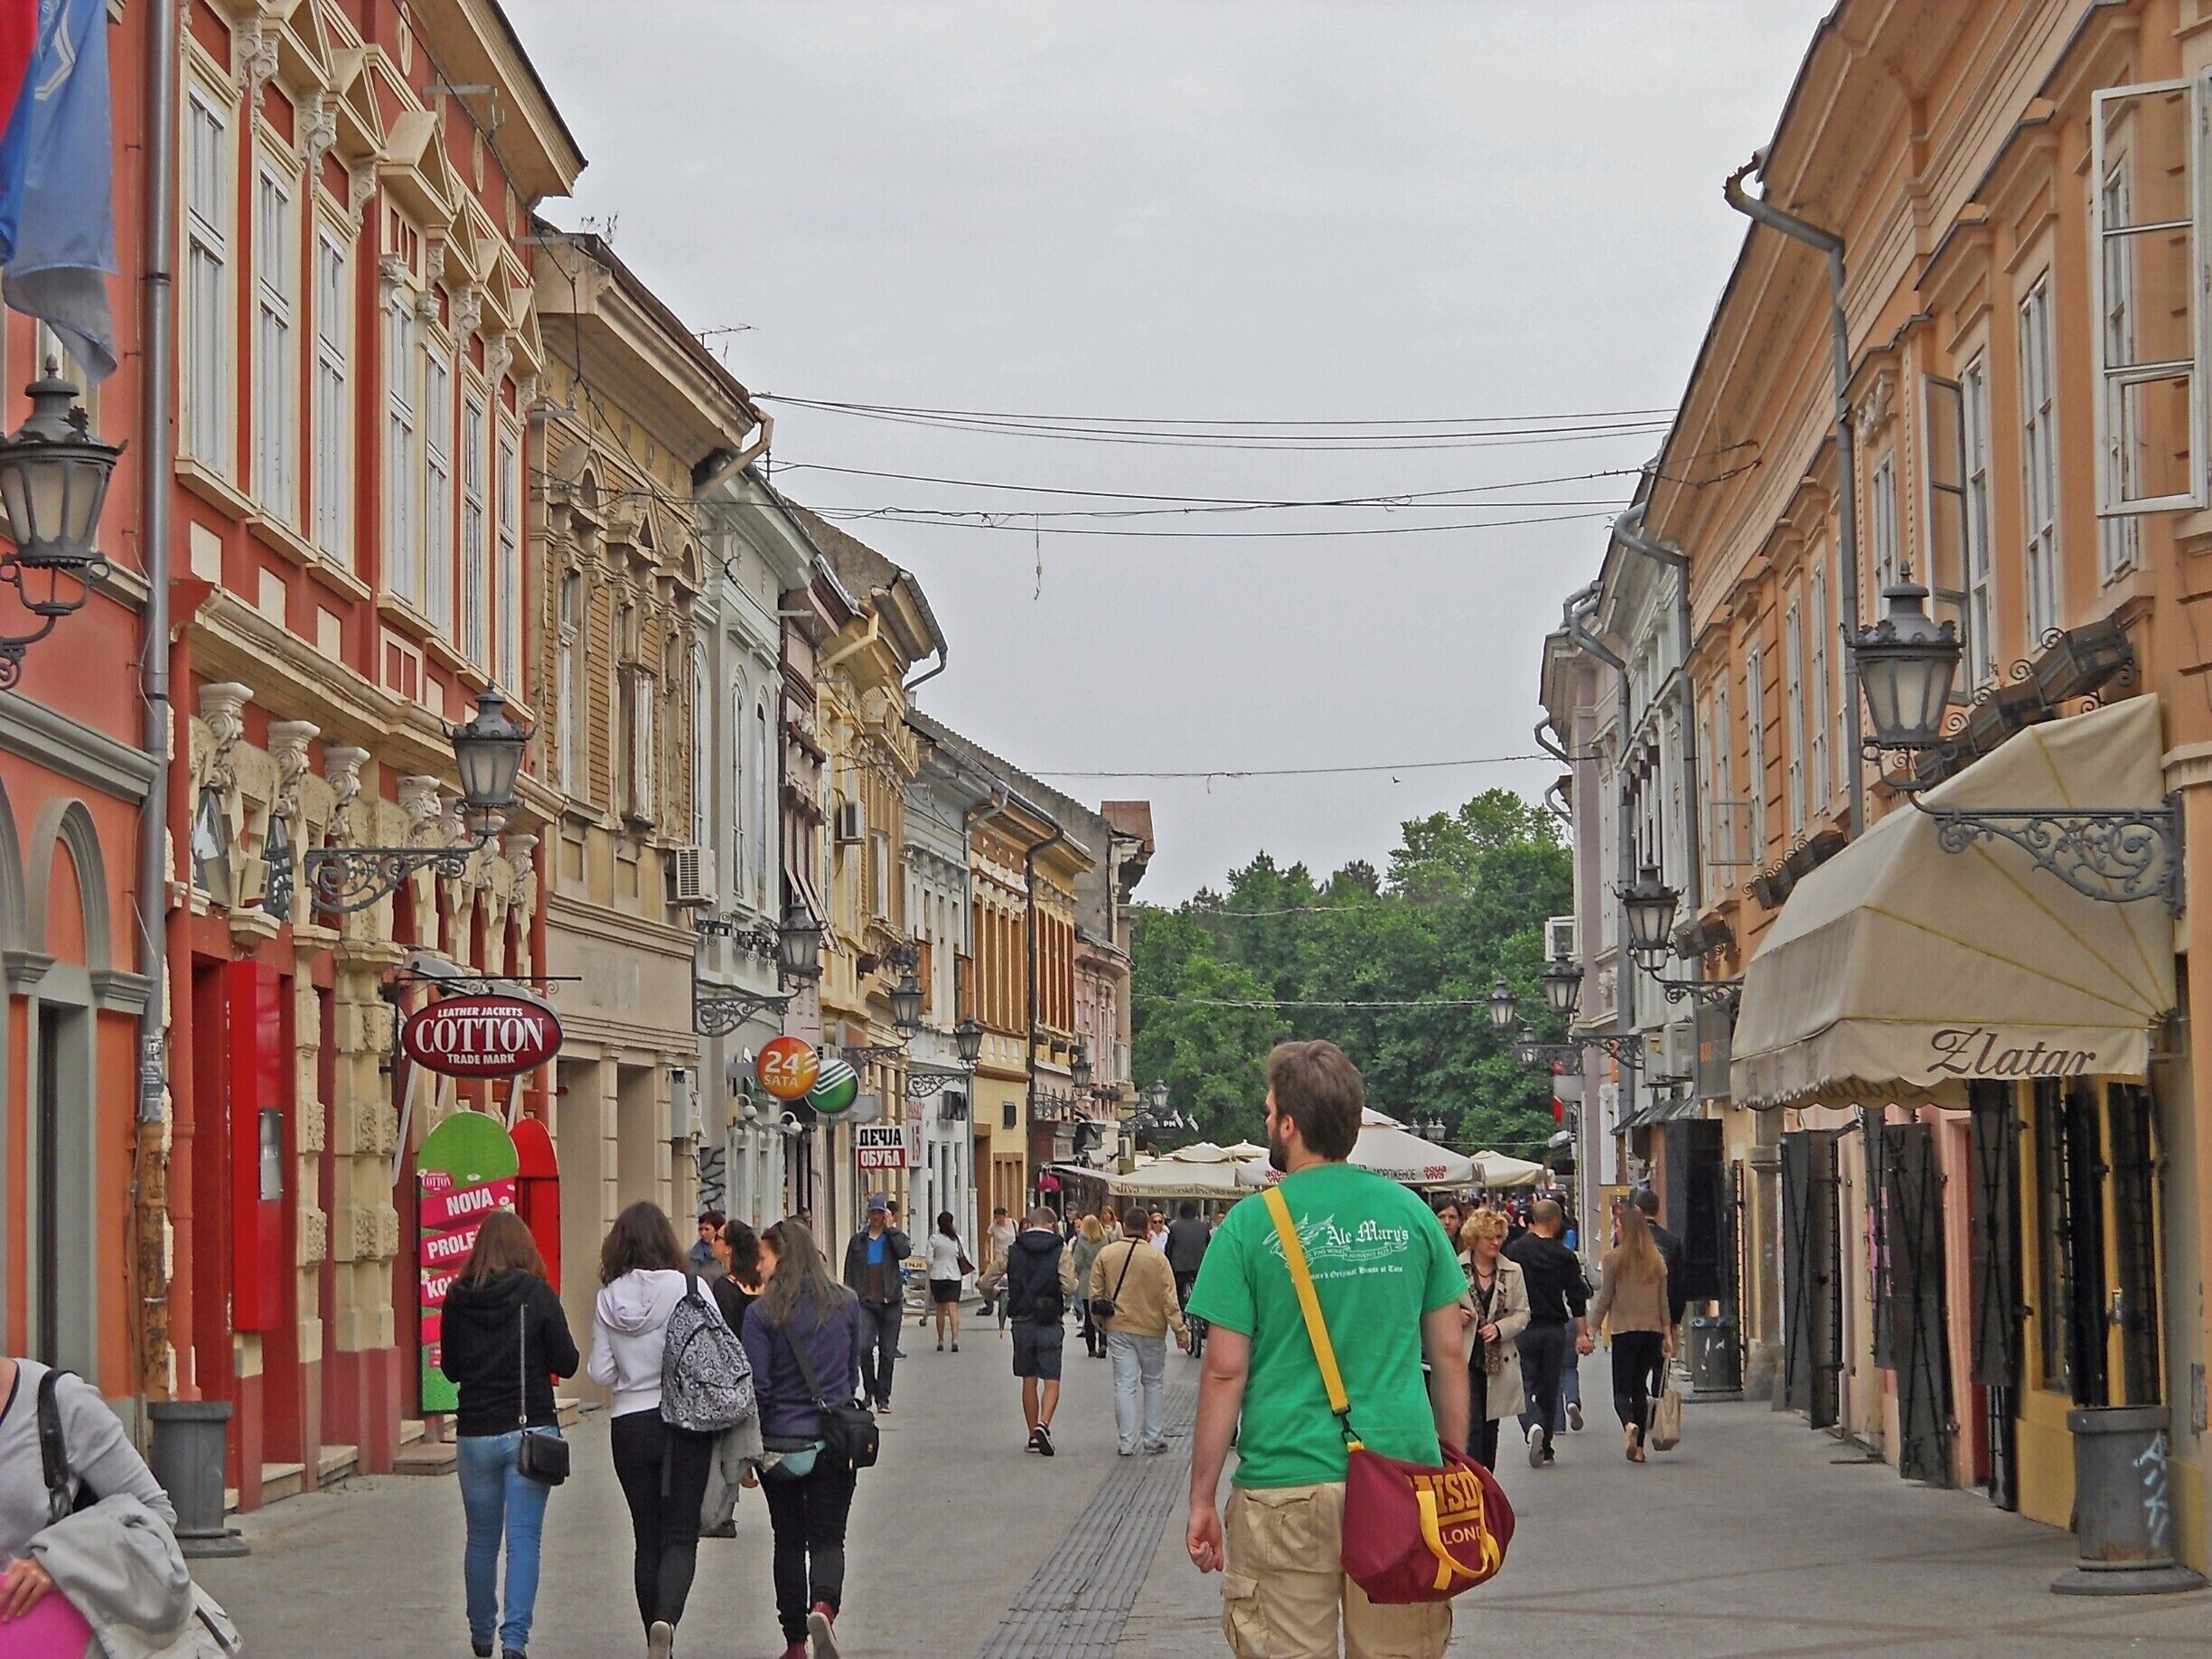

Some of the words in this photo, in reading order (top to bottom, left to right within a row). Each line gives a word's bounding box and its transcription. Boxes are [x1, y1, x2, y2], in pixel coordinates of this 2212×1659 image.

[437, 1008, 479, 1017] LEATHER
[481, 1007, 523, 1017] JACKETS
[415, 1017, 544, 1054] COTTON
[447, 1054, 480, 1064] TRADE
[483, 1053, 515, 1064] MARK
[1926, 1027, 2096, 1075] Zlatar
[764, 1050, 801, 1074] 24
[764, 1075, 799, 1088] SATA
[859, 1128, 903, 1147] ДЕЧЈА
[1265, 1170, 1286, 1178] aqu
[1423, 1165, 1448, 1174] aqua
[1425, 1172, 1445, 1180] viva
[445, 1187, 494, 1216] NOVA
[1326, 1225, 1353, 1247] Ale
[1355, 1219, 1410, 1243] Mary's
[426, 1230, 477, 1260] PROLE
